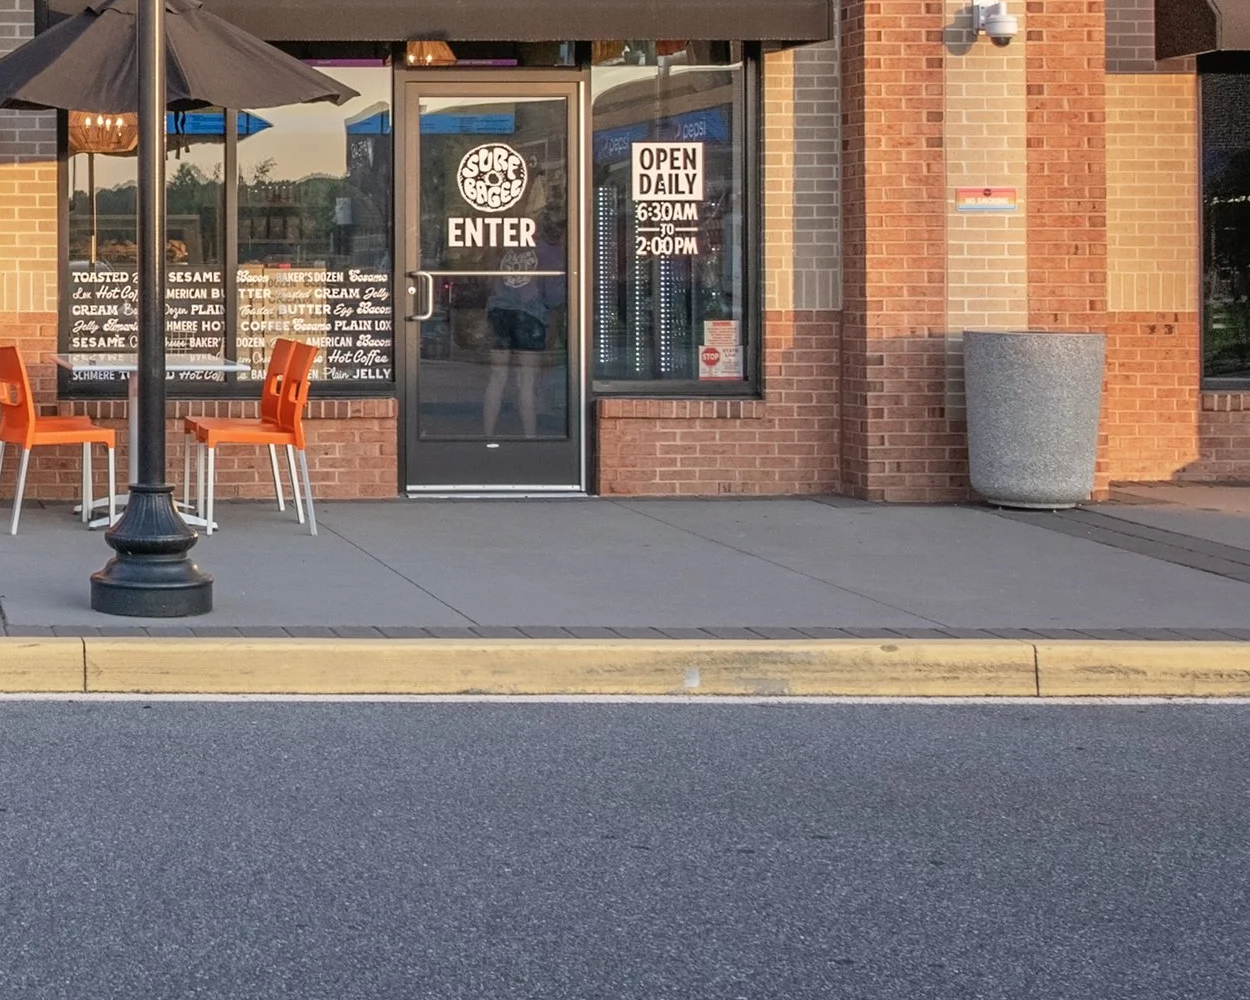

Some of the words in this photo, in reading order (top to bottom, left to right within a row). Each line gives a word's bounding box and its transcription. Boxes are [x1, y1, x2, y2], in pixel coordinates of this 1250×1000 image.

[682, 117, 707, 140] pepsi
[462, 147, 521, 180] SURF
[639, 148, 697, 170] OPEN
[639, 173, 697, 194] DAILY
[463, 178, 522, 208] BAGEL
[637, 202, 699, 221] 6:30AM
[448, 218, 537, 247] ENTER
[660, 223, 675, 235] TO
[72, 272, 129, 283] TOASTED
[168, 272, 221, 283] SESAME
[236, 270, 269, 283] Bacon
[276, 272, 313, 282] BAKER'S
[314, 272, 343, 282] DOZEN
[95, 285, 120, 299] Hot
[166, 288, 207, 299] MERICAN
[314, 288, 360, 299] CREAM
[364, 287, 390, 301] Jelly
[72, 305, 118, 316] CREAM
[279, 304, 331, 315] BUTTER
[333, 304, 354, 317] Egg
[356, 302, 392, 315] Bacon
[72, 320, 99, 333] Jelly
[167, 321, 198, 331] HMERE
[240, 320, 290, 331] COFFEE
[334, 320, 372, 331] PLAIN
[374, 320, 392, 331] LOX
[72, 337, 125, 348] SESAME
[236, 337, 265, 347] DOZEN
[306, 337, 352, 347] AMERICAN
[356, 334, 392, 347] Bacon
[329, 350, 351, 363] Hot
[353, 350, 388, 365] Coffee
[702, 353, 720, 361] STOP
[72, 371, 114, 381] SCHMERE
[353, 368, 391, 379] JELLY
